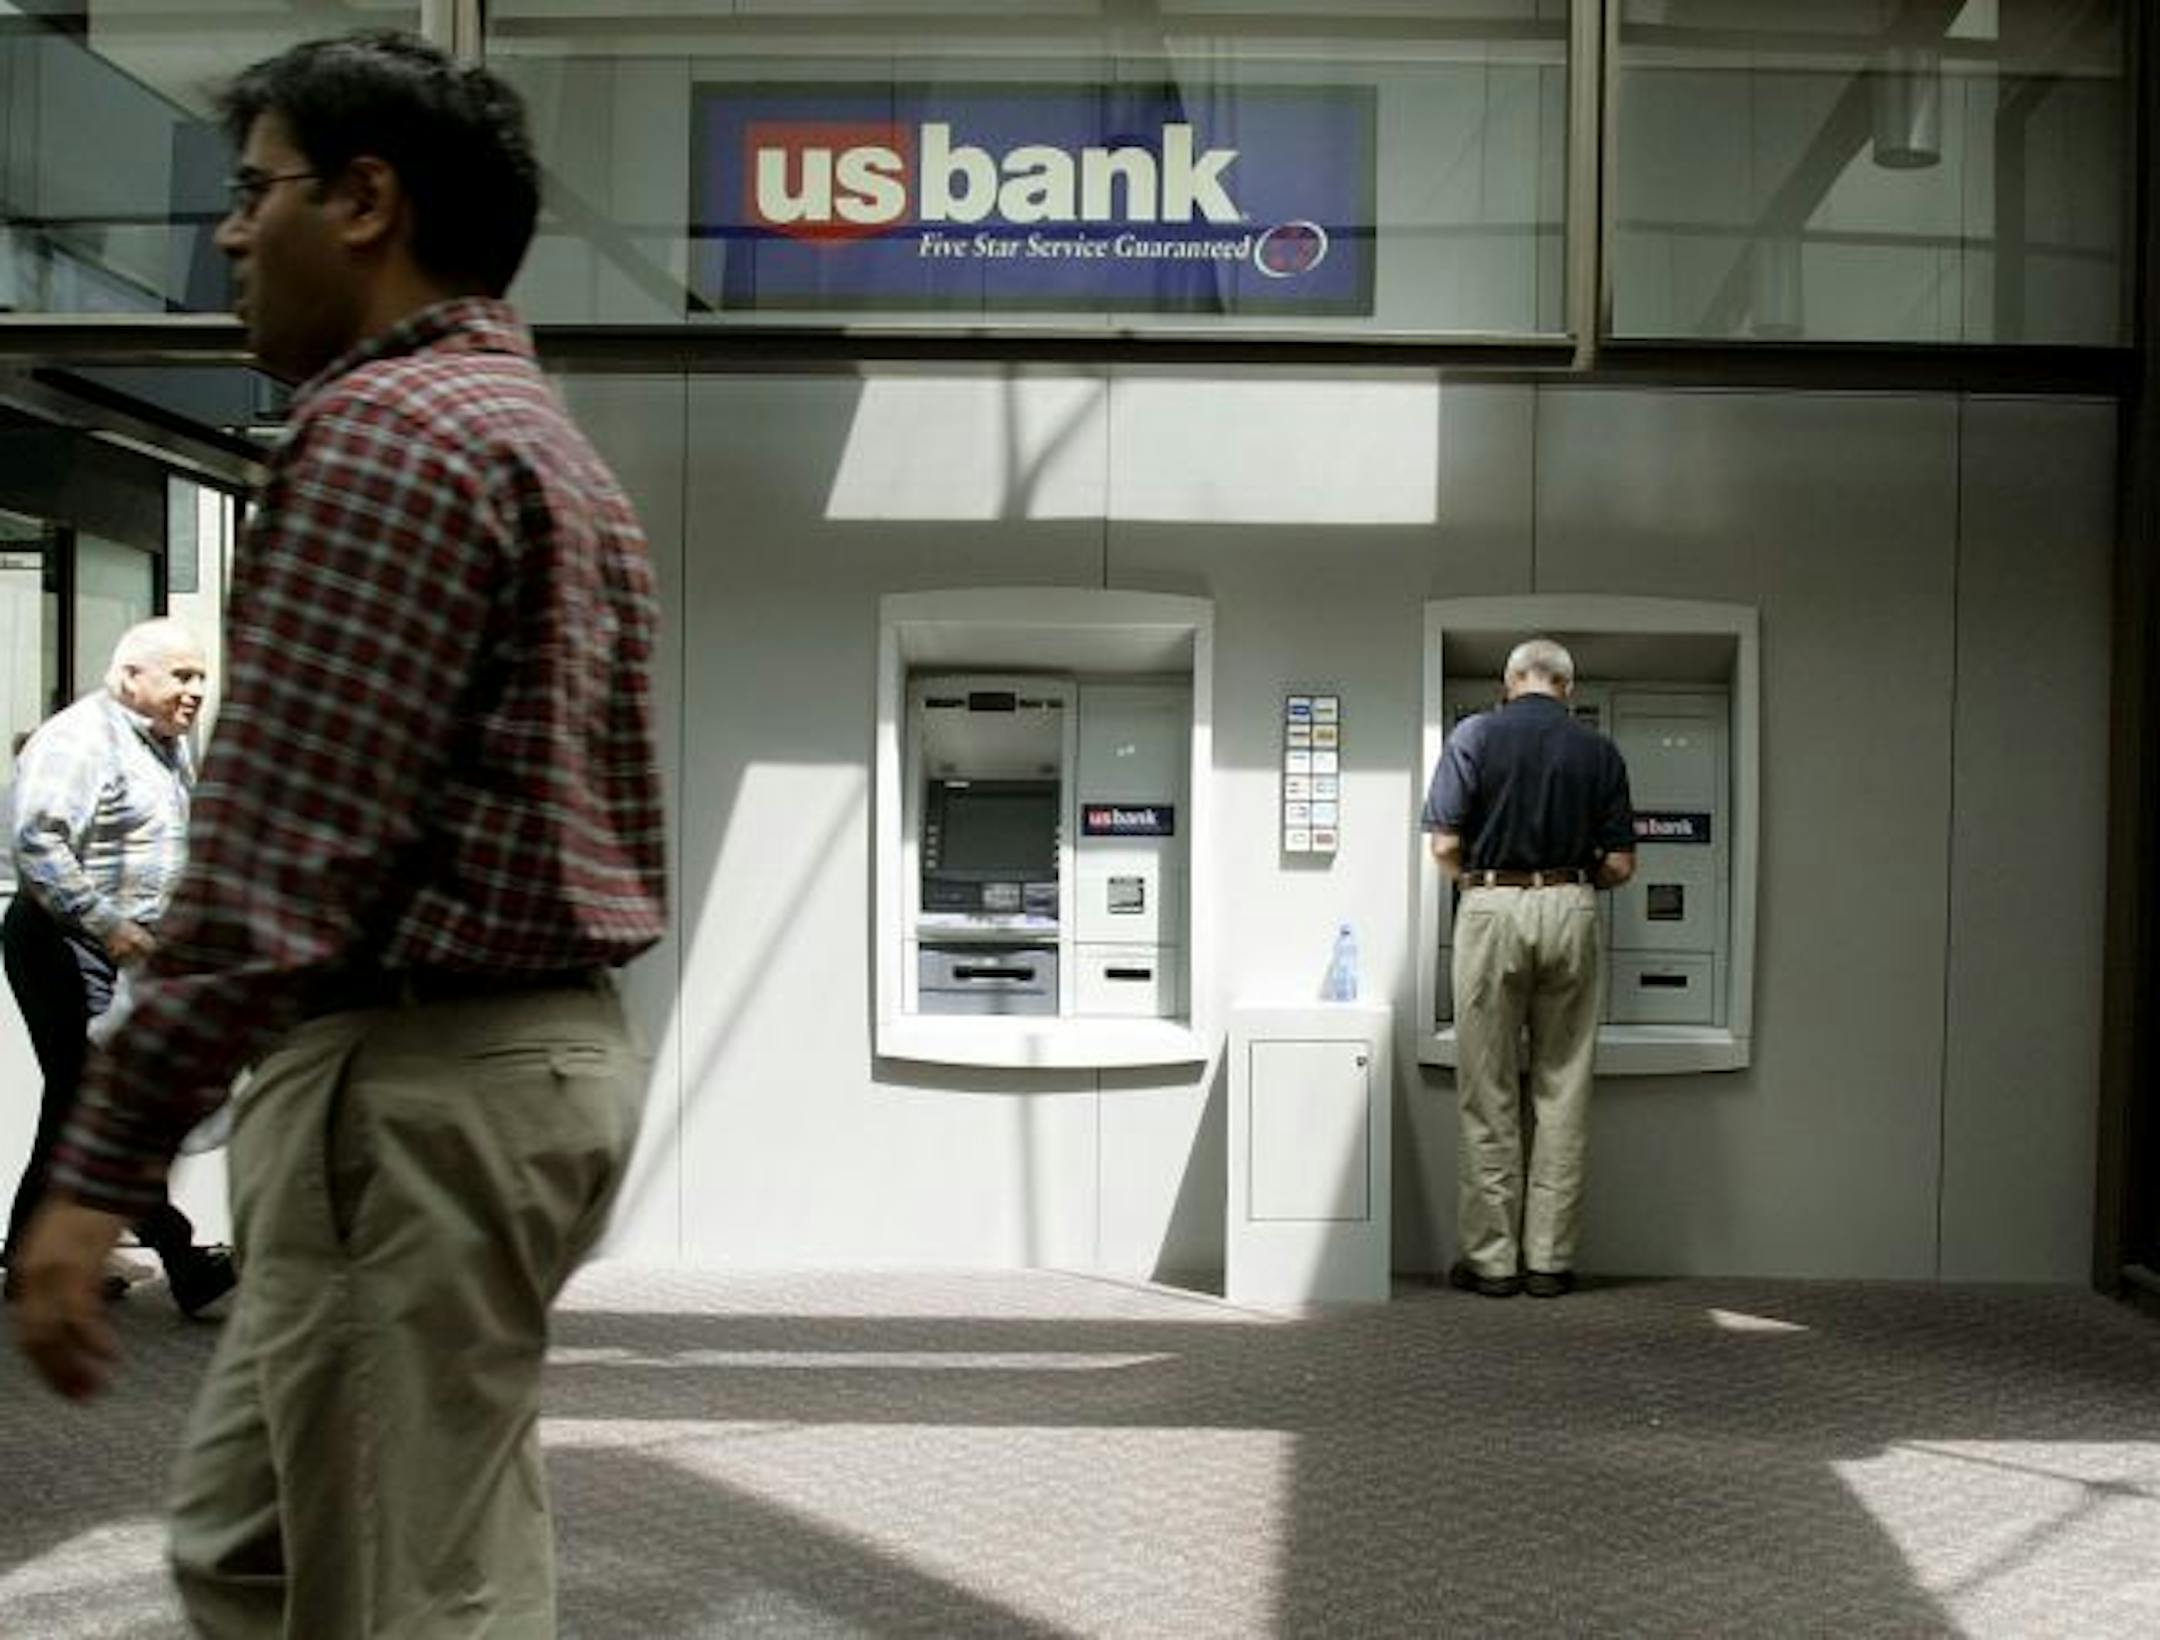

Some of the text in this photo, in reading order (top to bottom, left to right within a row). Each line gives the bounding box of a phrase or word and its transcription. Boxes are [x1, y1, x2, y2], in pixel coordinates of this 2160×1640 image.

[919, 231, 1250, 259] Five Star Service Guaranteed
